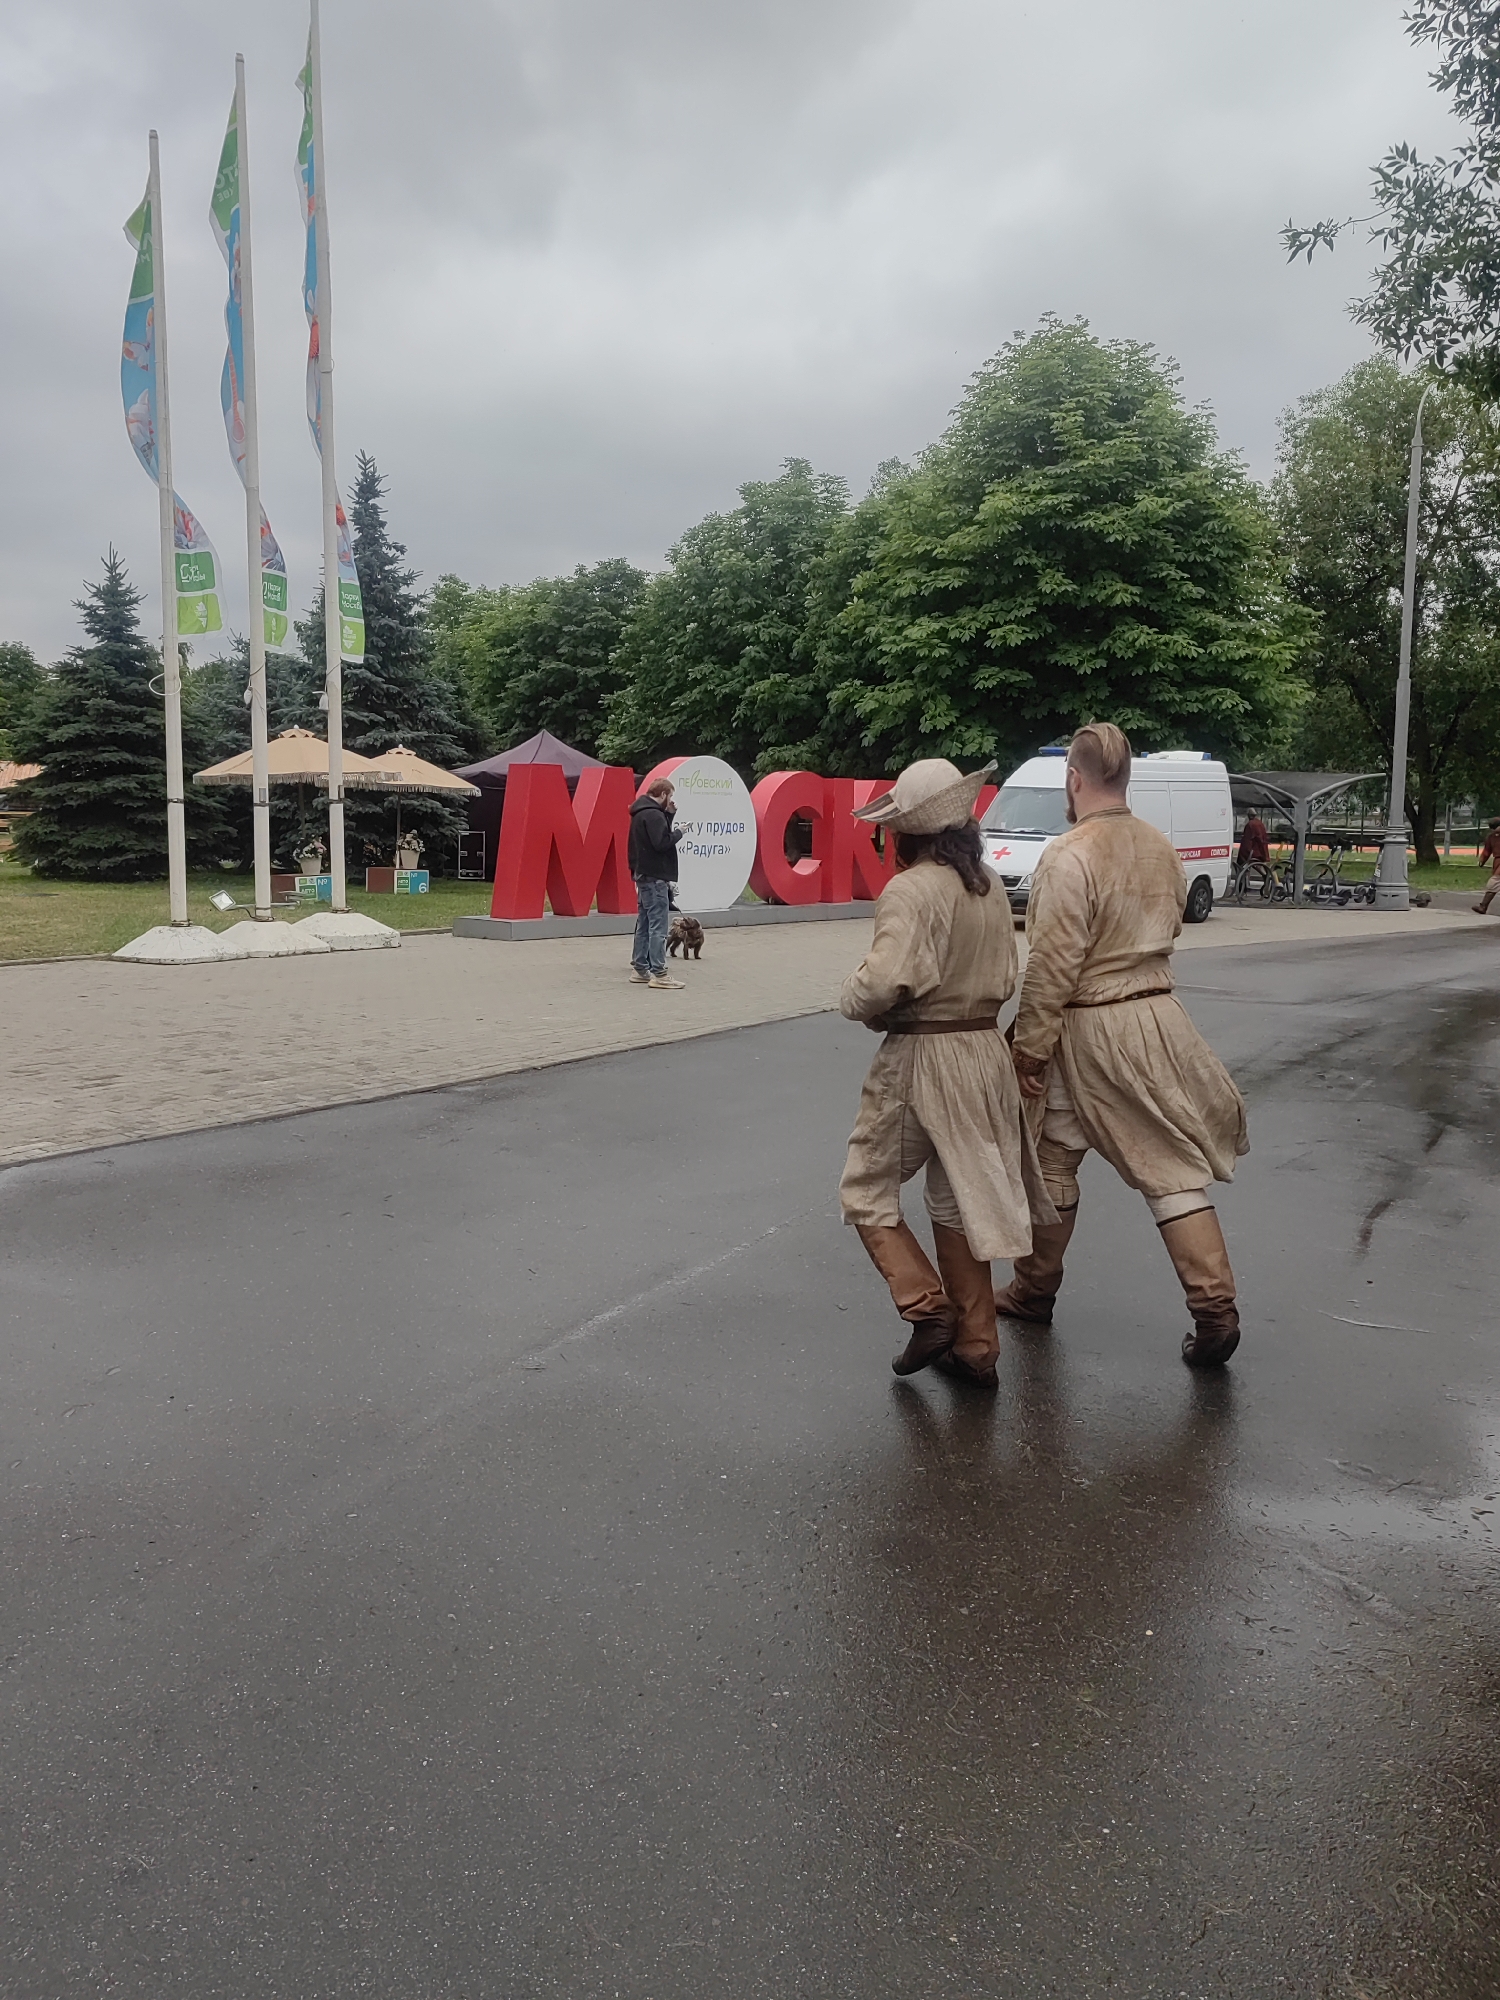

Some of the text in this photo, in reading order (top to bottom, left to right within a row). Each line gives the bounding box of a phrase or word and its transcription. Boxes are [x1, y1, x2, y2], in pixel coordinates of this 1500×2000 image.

[697, 822, 704, 836] у
[706, 822, 745, 837] прудов
[678, 840, 731, 858] «Радуга»
[418, 882, 427, 894] 6
